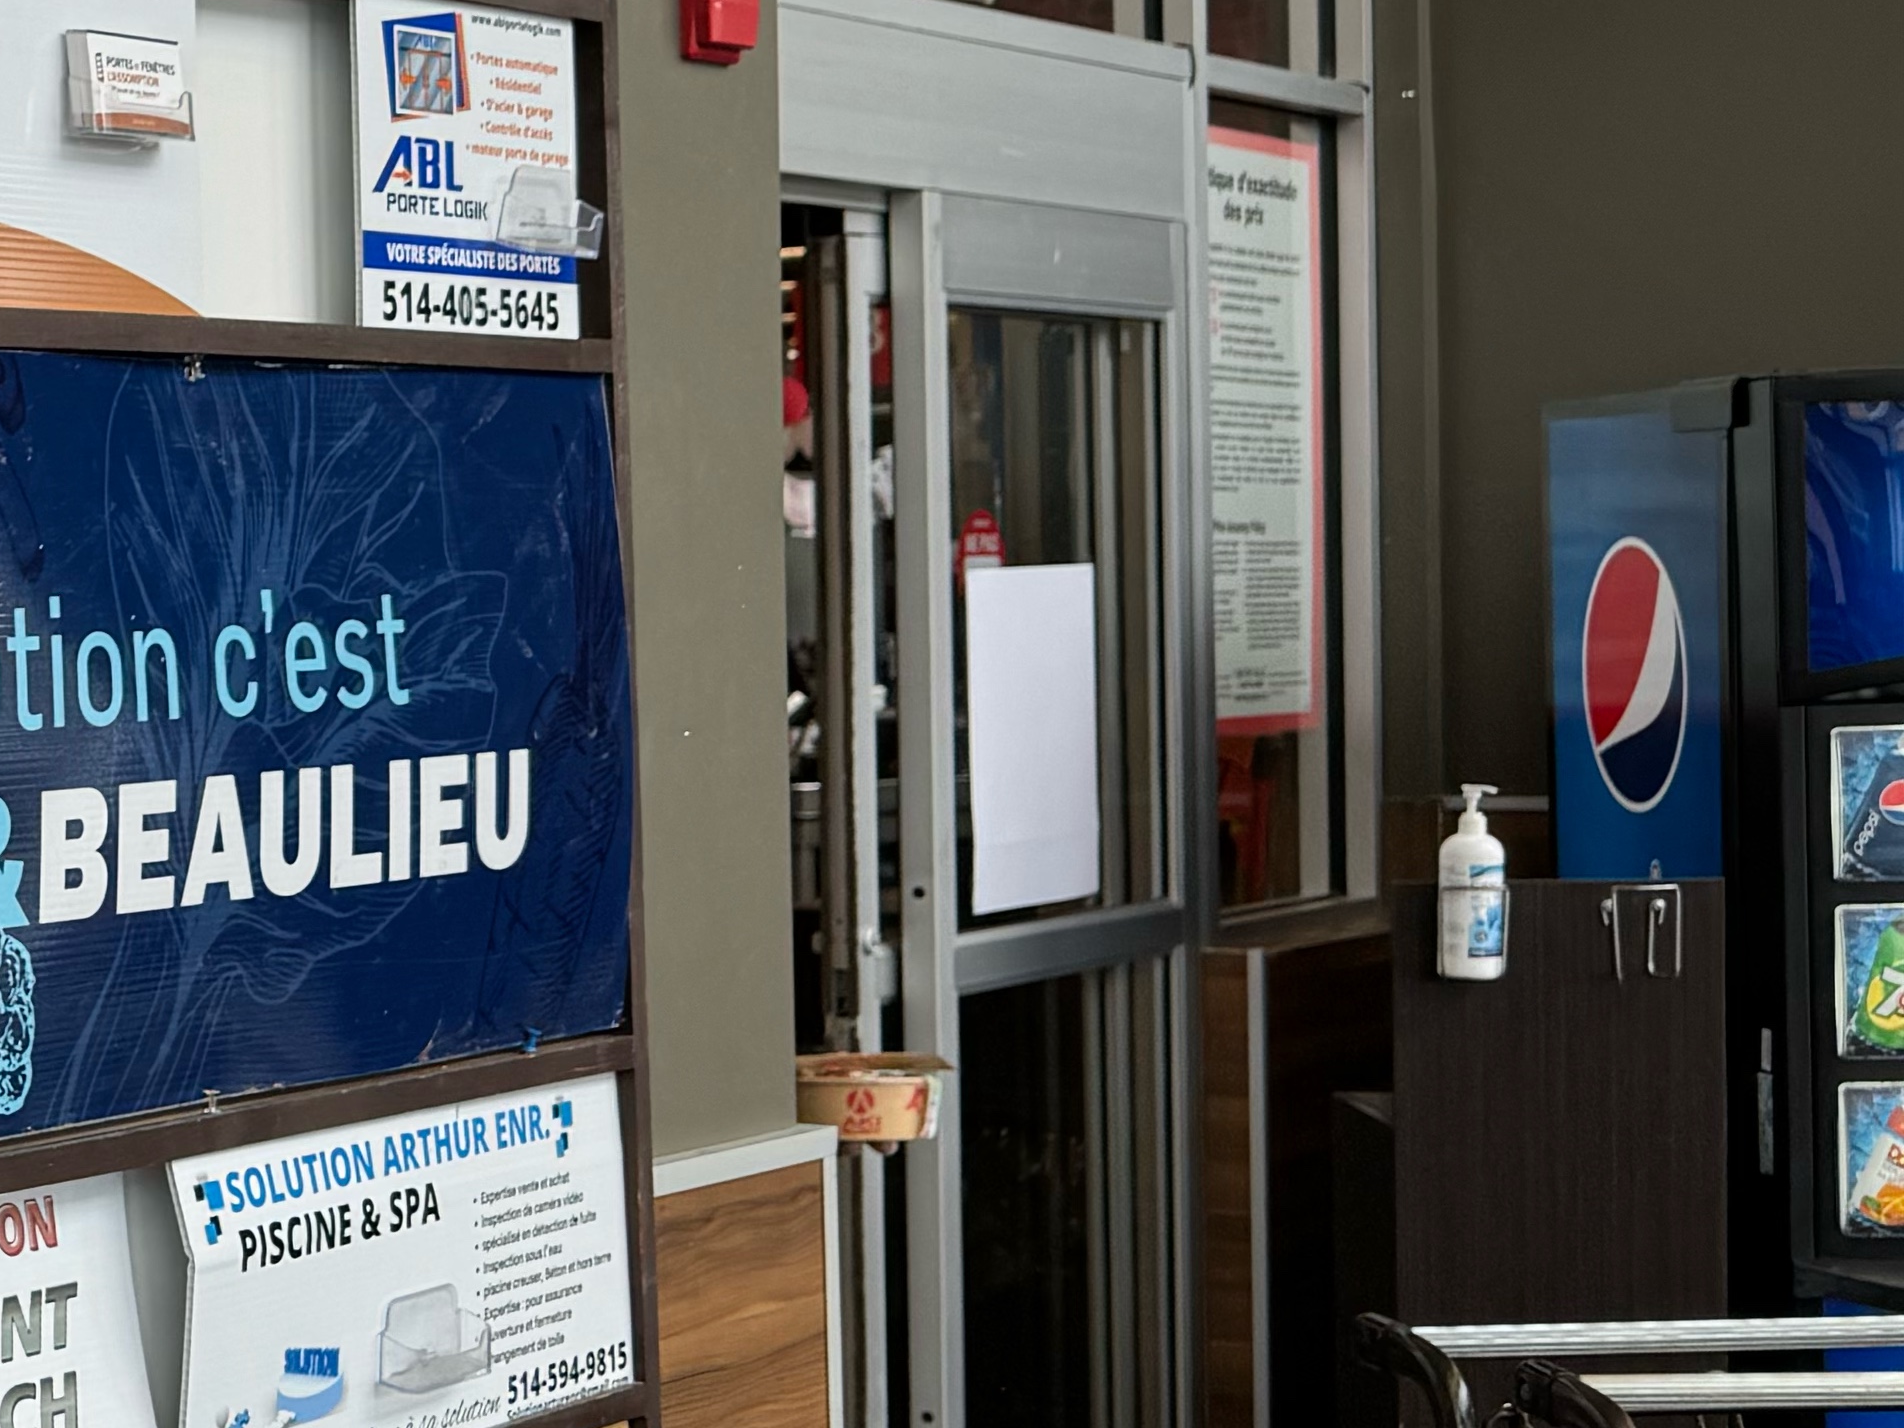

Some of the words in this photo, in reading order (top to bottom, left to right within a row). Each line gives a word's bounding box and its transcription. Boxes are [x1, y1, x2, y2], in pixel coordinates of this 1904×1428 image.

[372, 135, 463, 192] ABL
[387, 192, 439, 217] PORTE
[444, 198, 487, 221] LOGIK
[386, 242, 425, 264] VOTRE
[428, 243, 495, 270] SPÉCIALISTE
[498, 253, 517, 271] DES
[519, 254, 560, 275] PORTES
[383, 280, 559, 331] 514-405-5645
[213, 593, 410, 720] c'est
[1853, 809, 1881, 858] pepsi
[225, 1142, 374, 1213] SOLUTION
[383, 1115, 489, 1177] ARTHUR
[495, 1103, 550, 1152] ENR.
[239, 1203, 351, 1272] PISCINE
[361, 1198, 381, 1240] &
[390, 1182, 440, 1233] SPA
[284, 1347, 340, 1377] SOLUTION
[507, 1342, 627, 1405] 514-594-9815
[440, 1393, 501, 1428] solution
